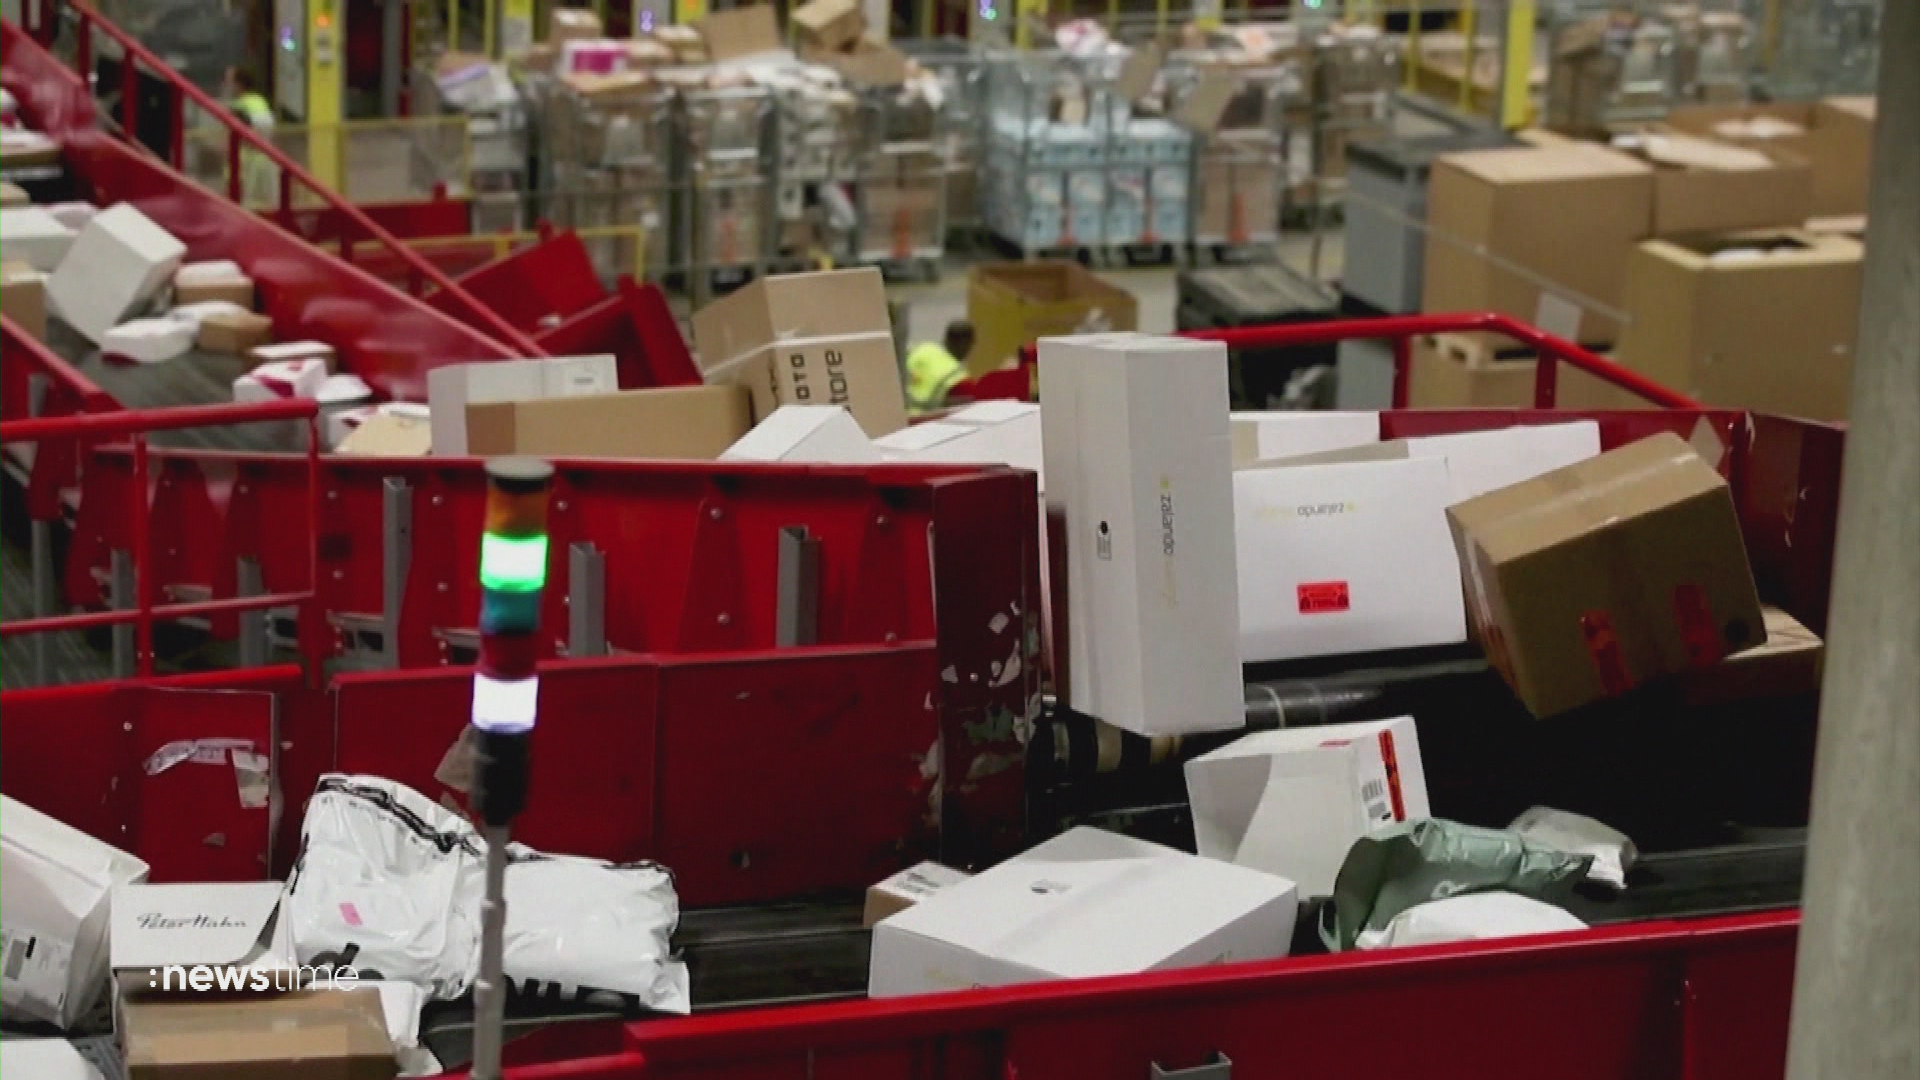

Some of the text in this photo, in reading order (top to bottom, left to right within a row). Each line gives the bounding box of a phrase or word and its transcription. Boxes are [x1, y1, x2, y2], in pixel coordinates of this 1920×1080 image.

[790, 353, 811, 406] OTO
[824, 350, 852, 414] tore
[1160, 494, 1177, 556] zalando
[1297, 502, 1344, 518] zalando
[136, 912, 248, 930] Peter Hahn
